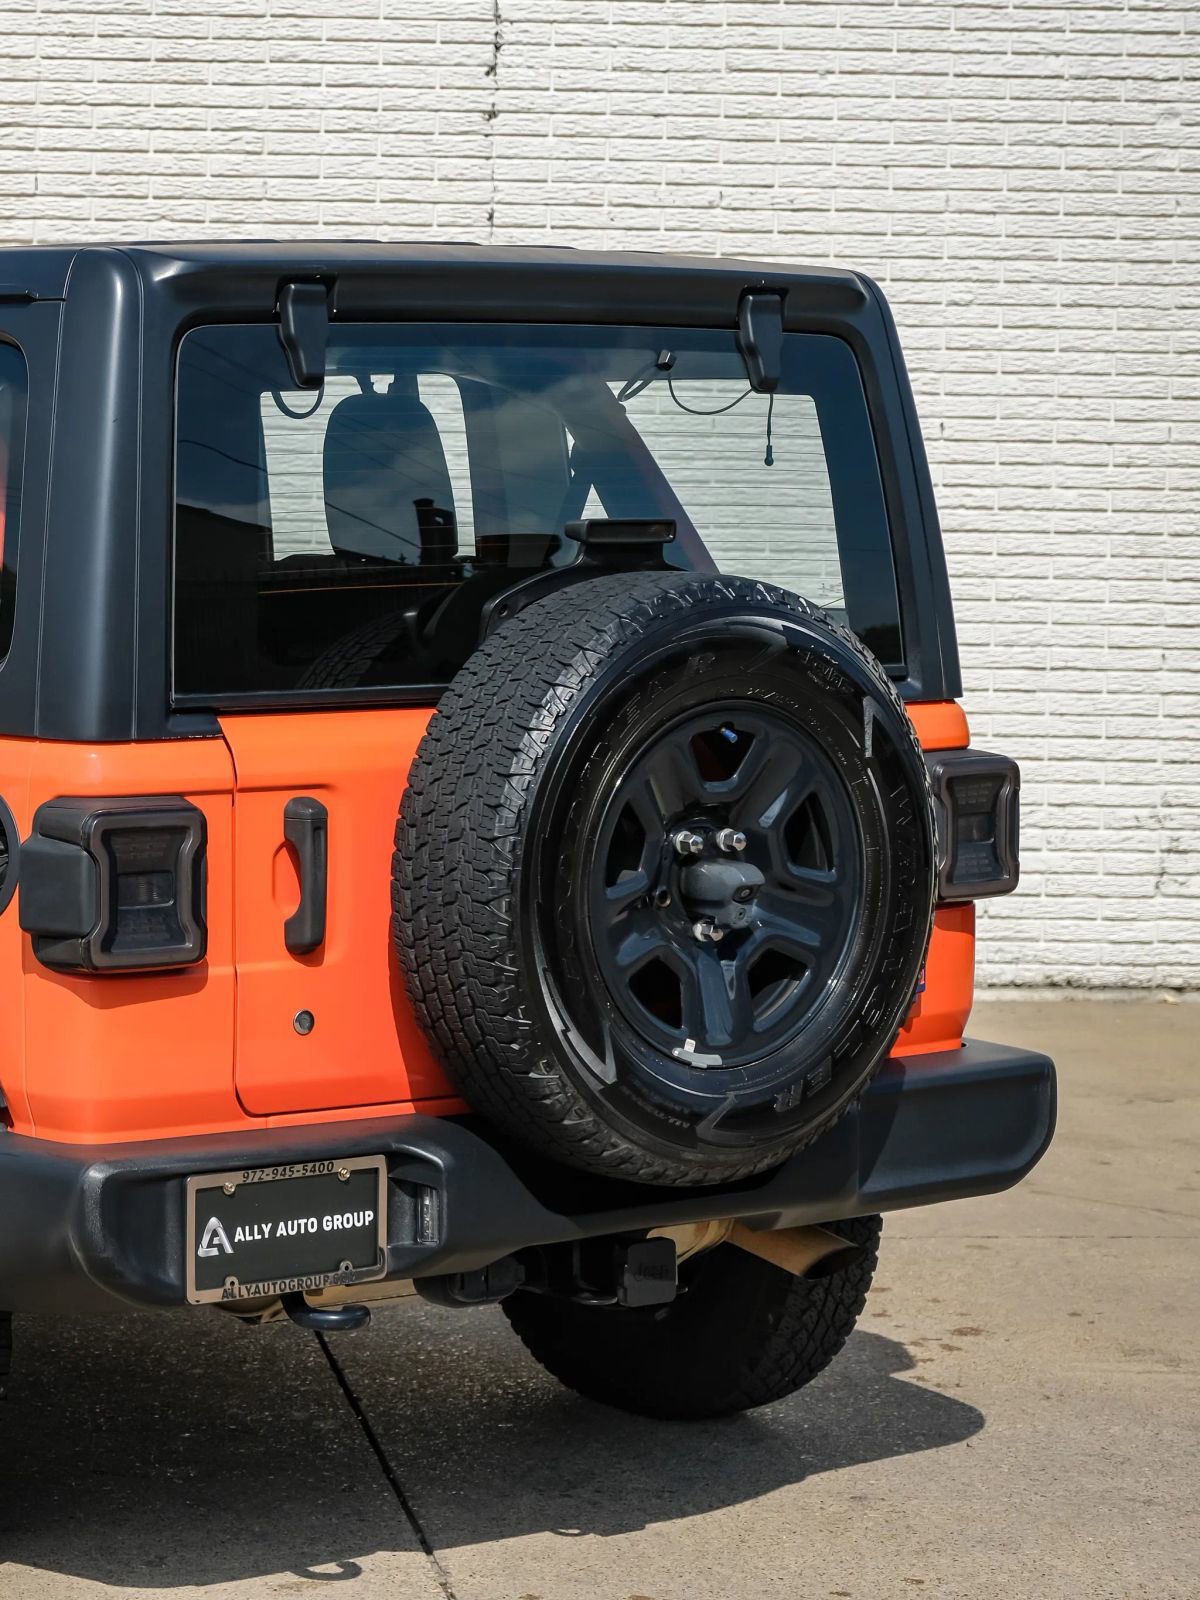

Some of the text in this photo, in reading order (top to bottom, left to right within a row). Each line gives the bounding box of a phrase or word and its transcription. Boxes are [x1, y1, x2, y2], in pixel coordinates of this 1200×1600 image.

[242, 1161, 334, 1183] 972-945-5400
[235, 1210, 374, 1242] ALLY AUTO GROUP
